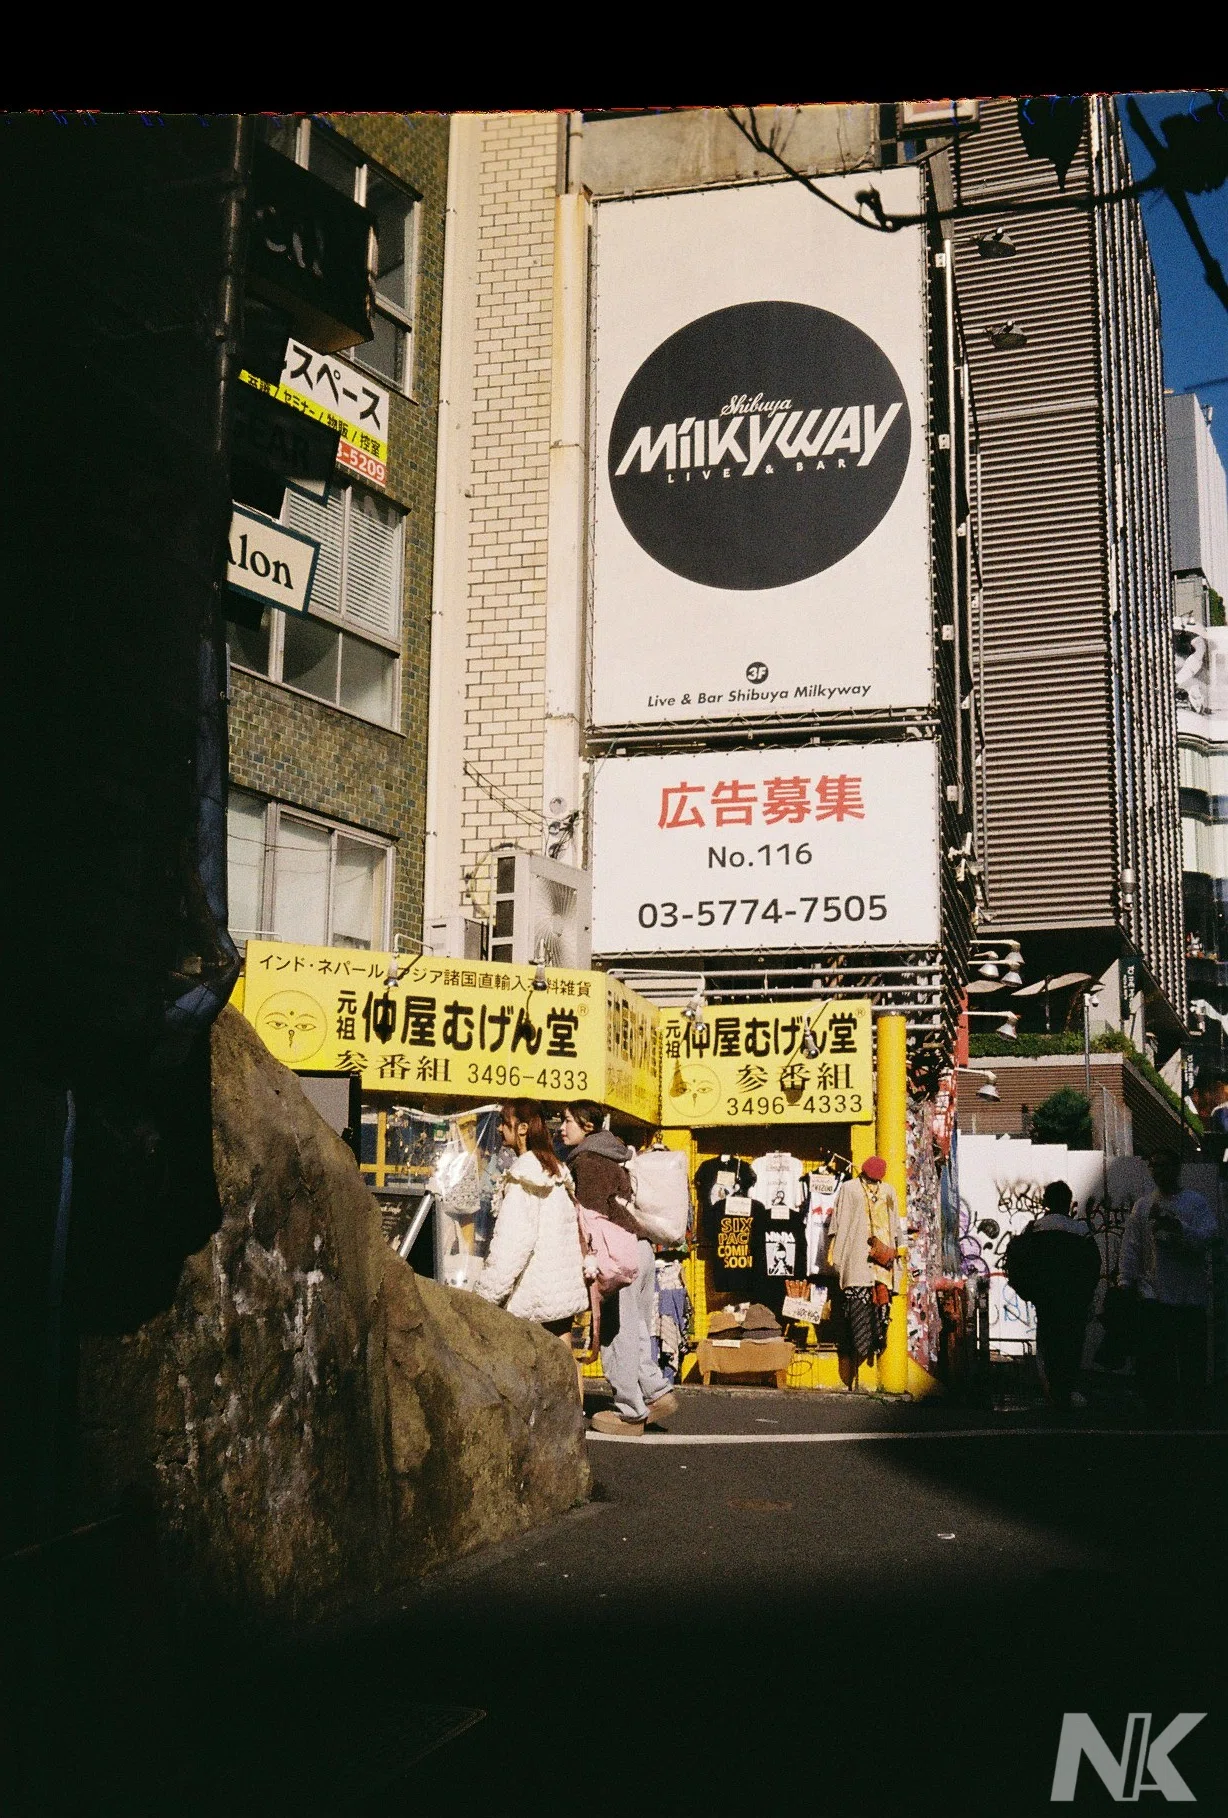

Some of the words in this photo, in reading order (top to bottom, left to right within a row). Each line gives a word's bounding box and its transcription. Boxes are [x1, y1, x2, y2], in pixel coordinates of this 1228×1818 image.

[285, 344, 381, 431] スペース
[720, 392, 793, 418] Shibuya
[667, 468, 731, 484] LIVE
[765, 464, 774, 475] &
[796, 458, 847, 472] BAR
[746, 666, 767, 681] 3F
[647, 694, 676, 707] Live
[681, 693, 692, 705] &
[698, 692, 723, 704] Bar
[728, 688, 789, 703] Shibuya
[794, 684, 872, 699] Milkyway
[657, 774, 866, 830] 広告募集
[707, 842, 813, 869] No.116
[638, 894, 888, 929] 03-5774-7505
[336, 989, 358, 1041] 元祖
[665, 1019, 682, 1059] 元祖
[467, 1063, 589, 1092] 3496-4333
[736, 1061, 854, 1094] 参番組
[726, 1094, 863, 1117] 3496-4333
[720, 1217, 754, 1234] SIX
